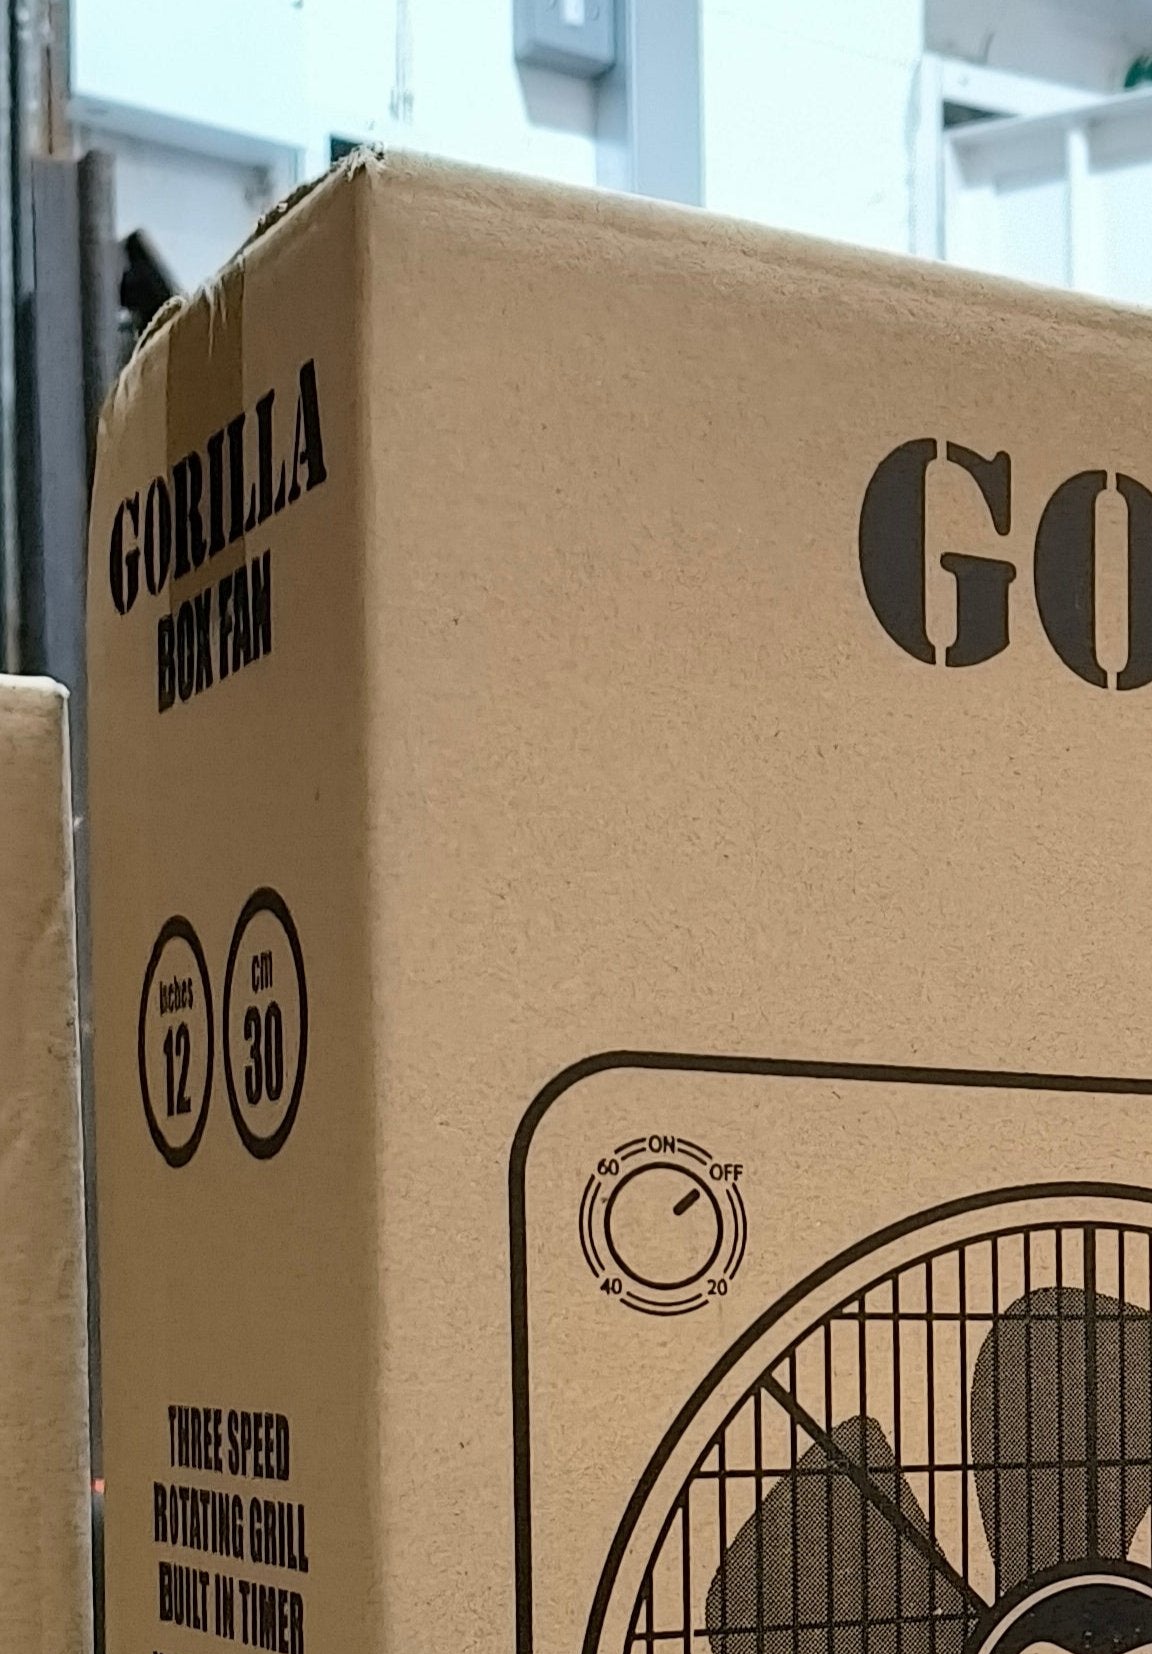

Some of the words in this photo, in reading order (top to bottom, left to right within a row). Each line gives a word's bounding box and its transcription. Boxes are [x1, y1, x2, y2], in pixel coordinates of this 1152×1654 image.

[109, 358, 327, 615] GORILLA
[158, 585, 213, 714] BOX
[218, 549, 272, 681] FAN
[251, 951, 273, 994] cm
[163, 1021, 191, 1117] 12
[243, 1001, 283, 1106] 30
[597, 1158, 619, 1176] 60
[649, 1134, 675, 1154] ON
[709, 1163, 744, 1181] OFF
[600, 1278, 622, 1295] 40
[707, 1278, 728, 1296] 20
[168, 1404, 223, 1474] THREE
[228, 1409, 290, 1481] SPEED
[153, 1481, 245, 1560] ROTATING
[250, 1497, 309, 1573] GRILL
[159, 1561, 210, 1633] BUILT
[215, 1572, 235, 1640] IN
